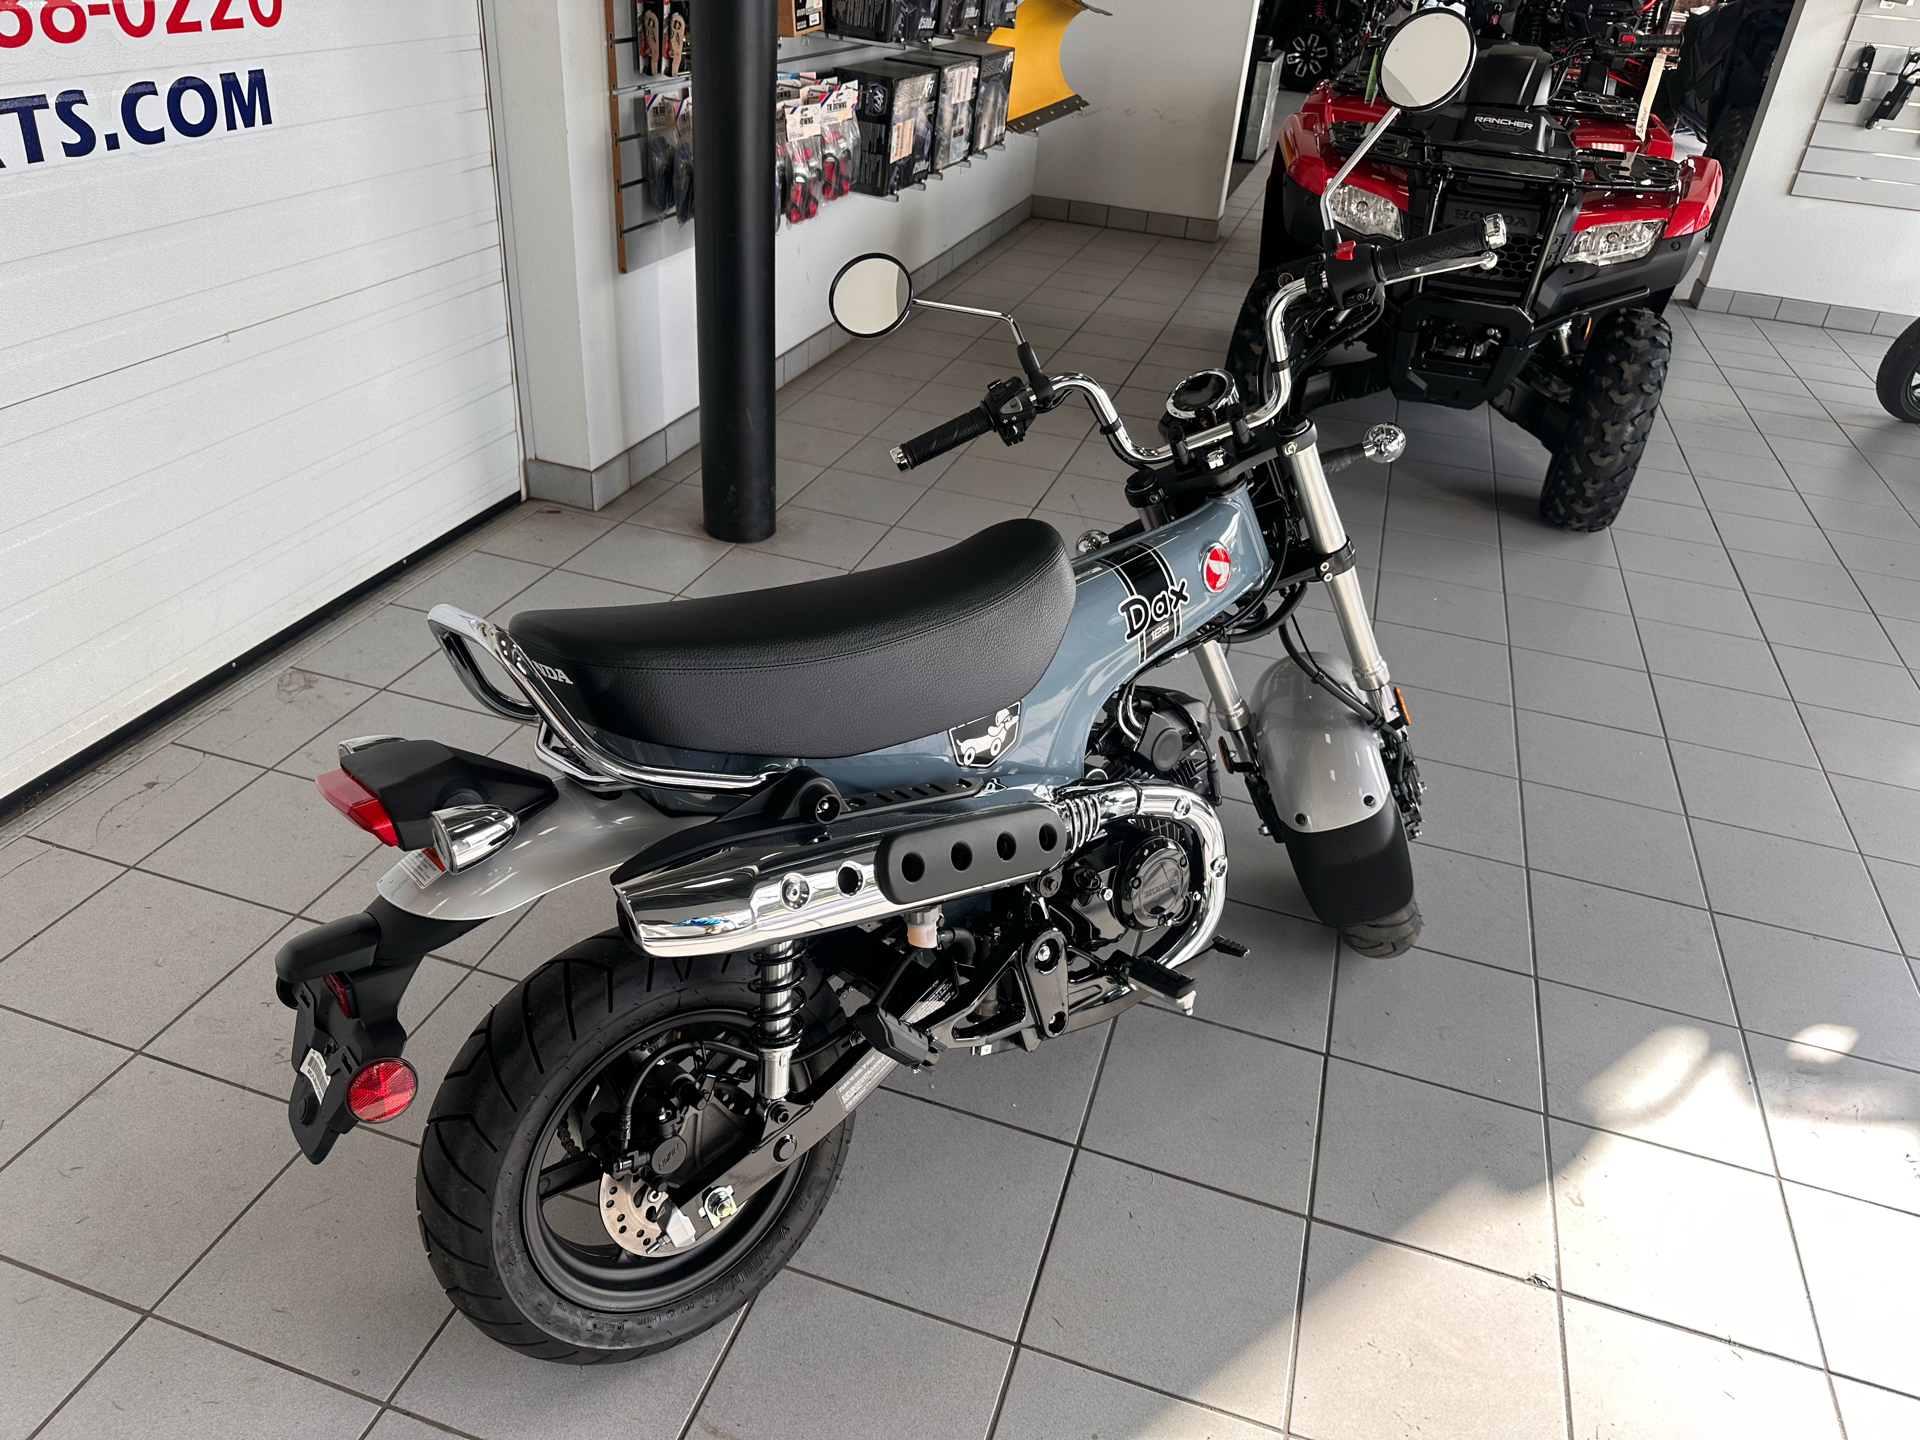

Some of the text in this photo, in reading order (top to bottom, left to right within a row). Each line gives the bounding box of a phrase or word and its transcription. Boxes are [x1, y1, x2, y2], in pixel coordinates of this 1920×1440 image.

[0, 68, 272, 168] TS.COM
[1474, 116, 1534, 130] RANCHER
[1453, 209, 1530, 228] HODA
[1118, 578, 1190, 643] Dax
[1150, 621, 1170, 641] 125
[532, 660, 574, 685] NDA
